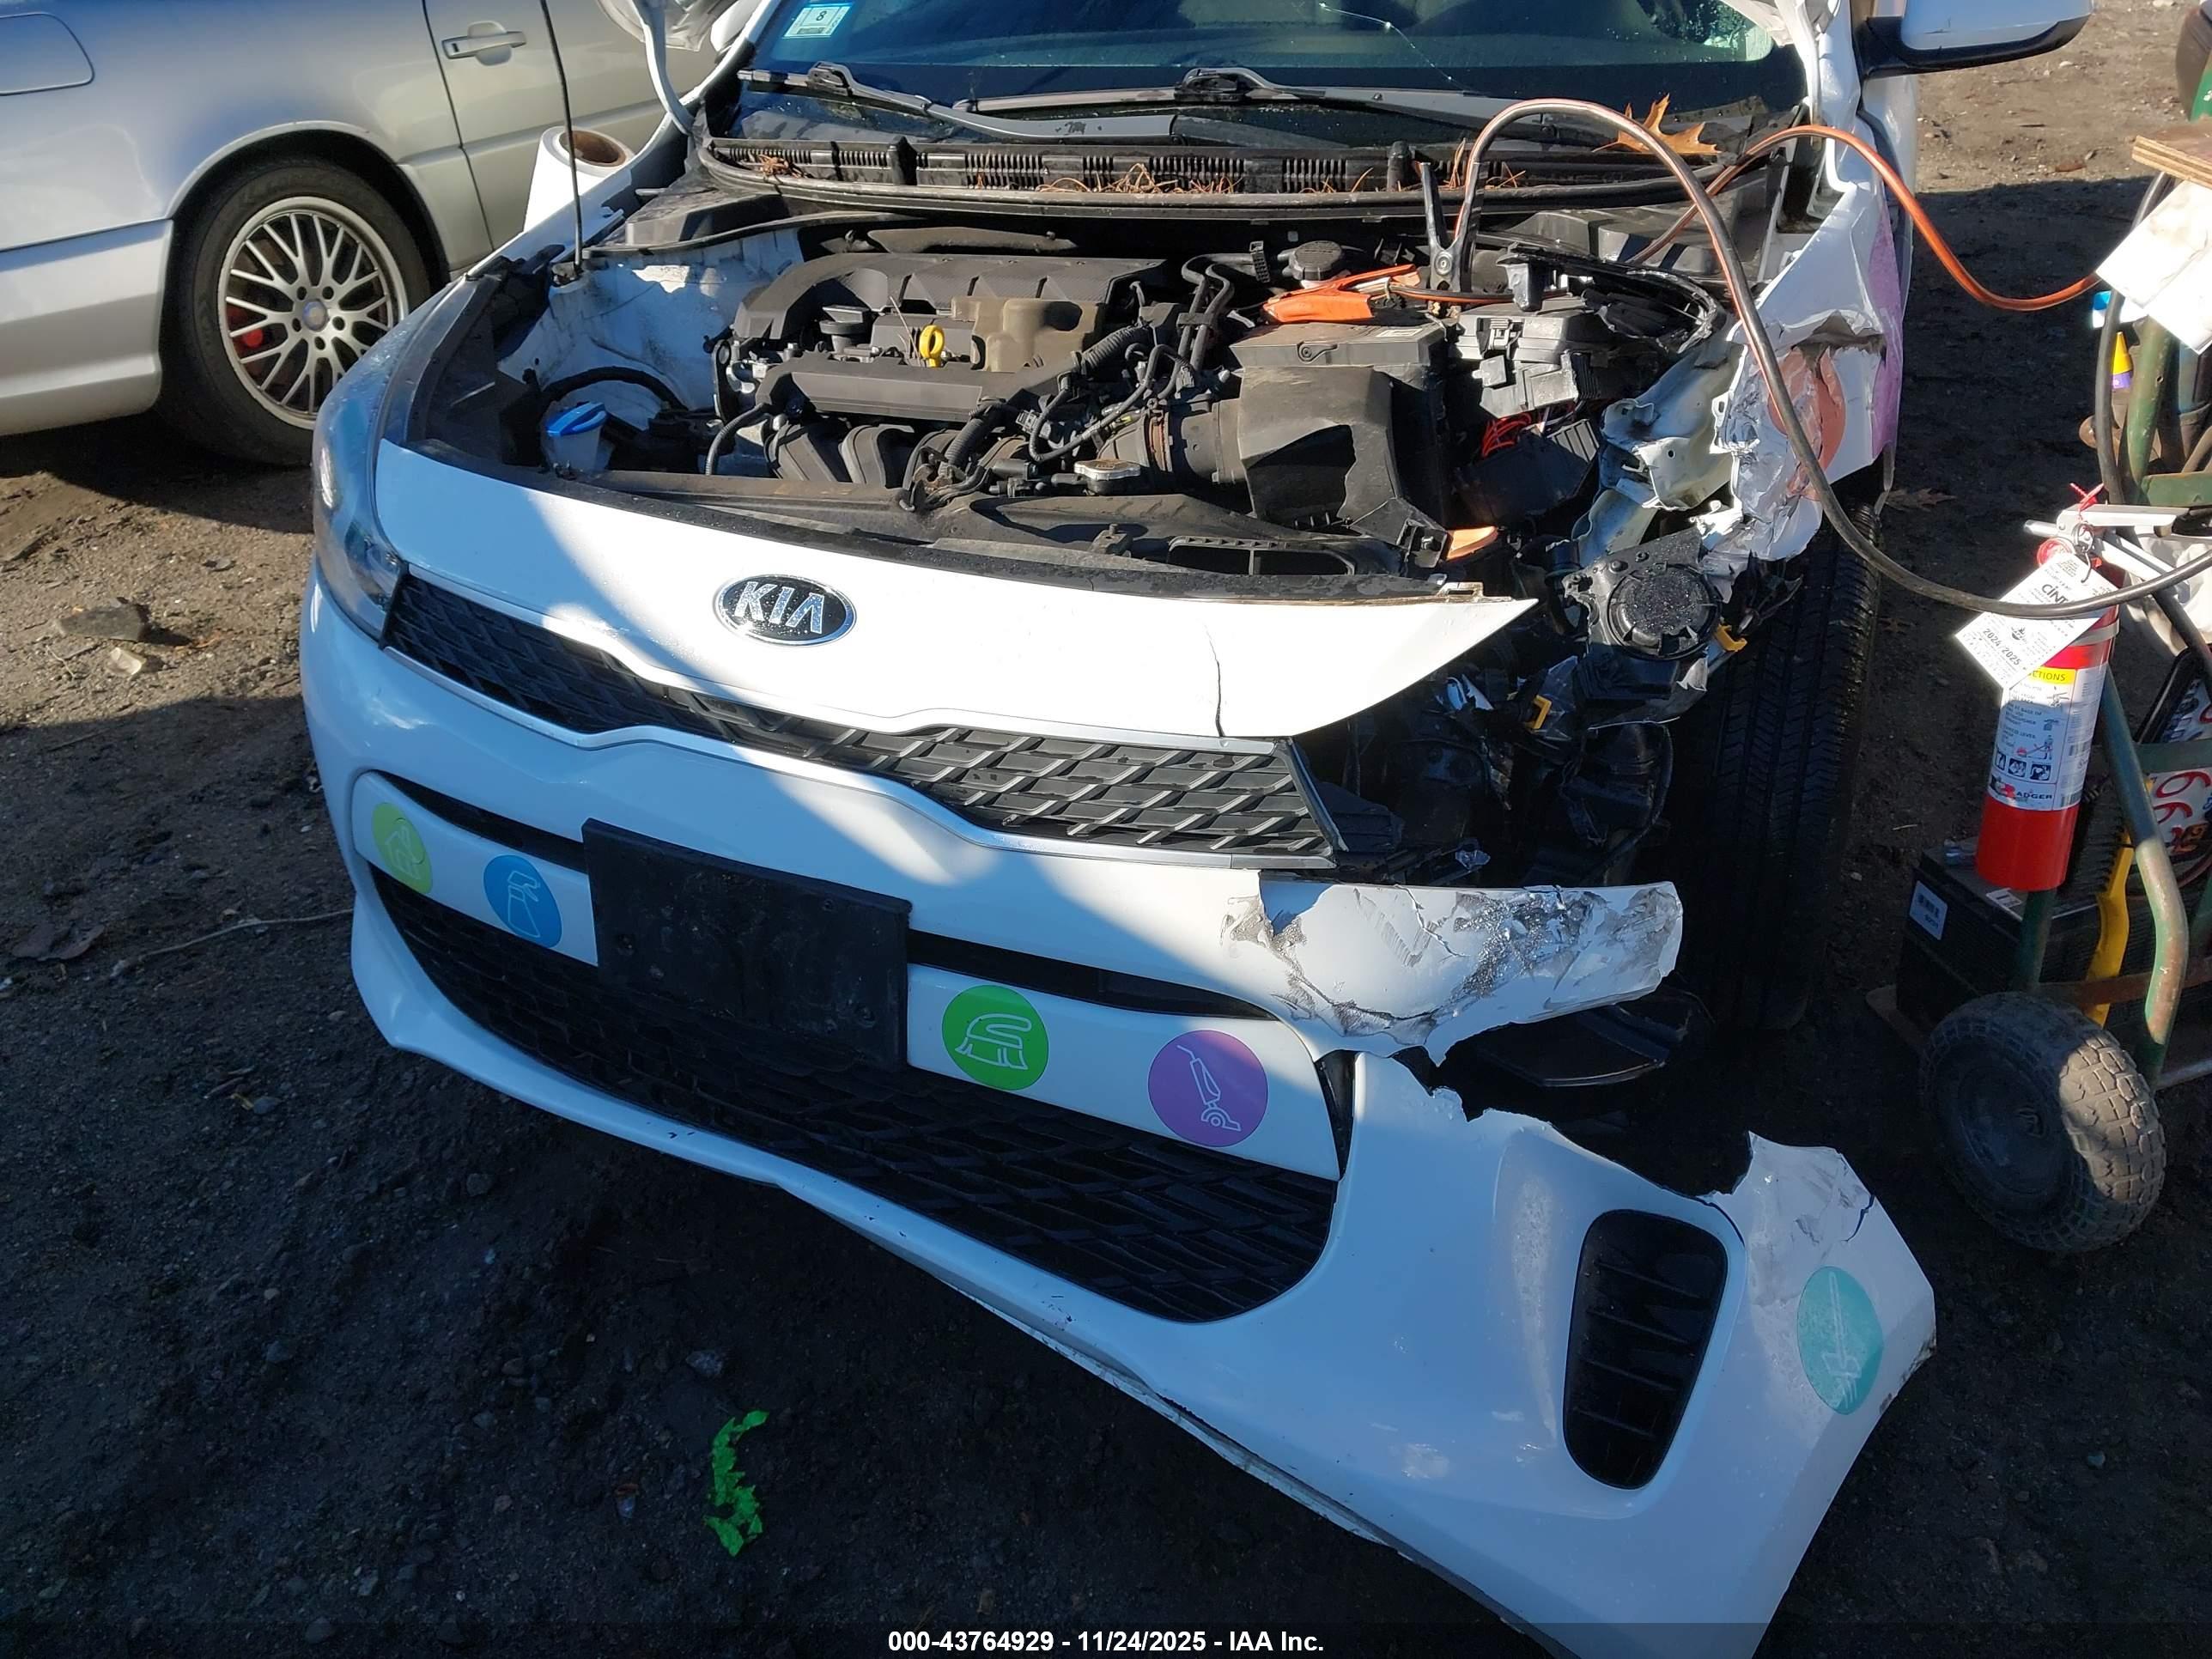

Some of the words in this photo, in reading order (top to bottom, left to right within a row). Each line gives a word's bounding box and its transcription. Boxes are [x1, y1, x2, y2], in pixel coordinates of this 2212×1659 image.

[816, 10, 827, 21] 8
[734, 581, 825, 635] KIA
[1983, 628, 2022, 665] 2024/2025
[2028, 669, 2067, 682] CTIONS
